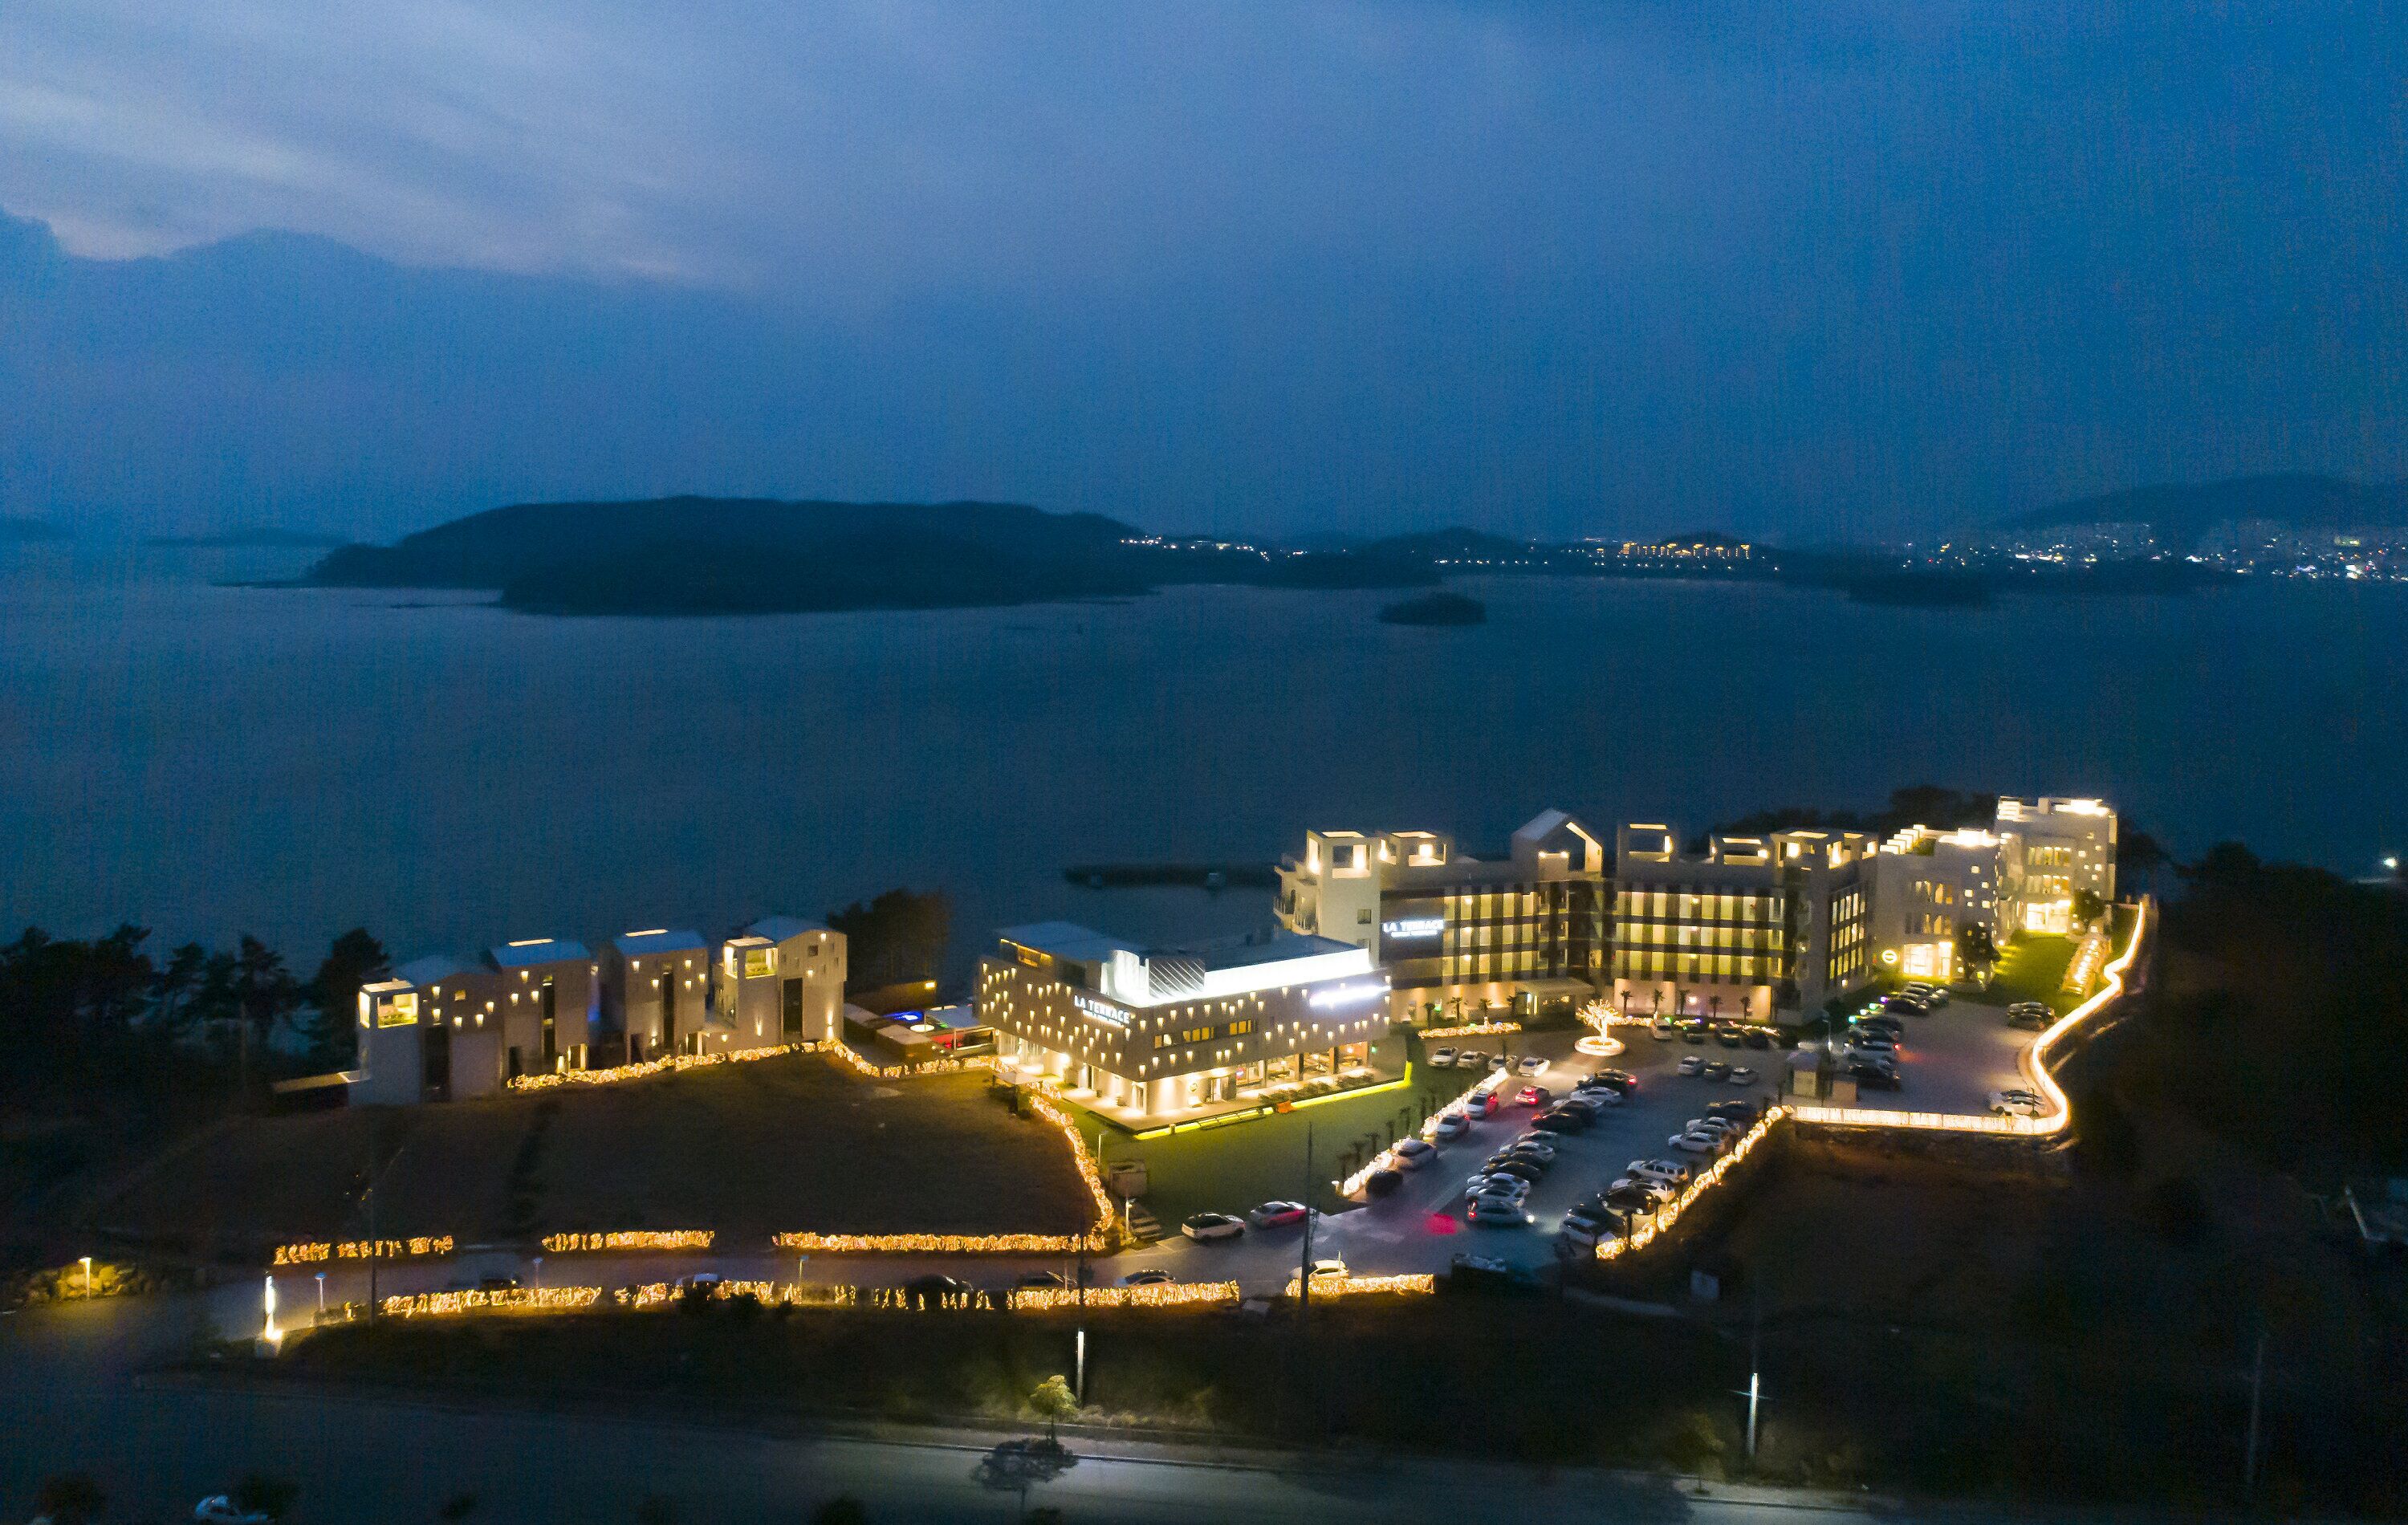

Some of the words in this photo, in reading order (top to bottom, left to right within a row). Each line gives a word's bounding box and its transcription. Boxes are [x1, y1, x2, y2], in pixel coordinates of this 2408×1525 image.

[1383, 922, 1397, 933] LA
[1400, 919, 1444, 932] TERRACE
[1074, 994, 1086, 1009] LA
[1088, 999, 1130, 1024] TERRACE
